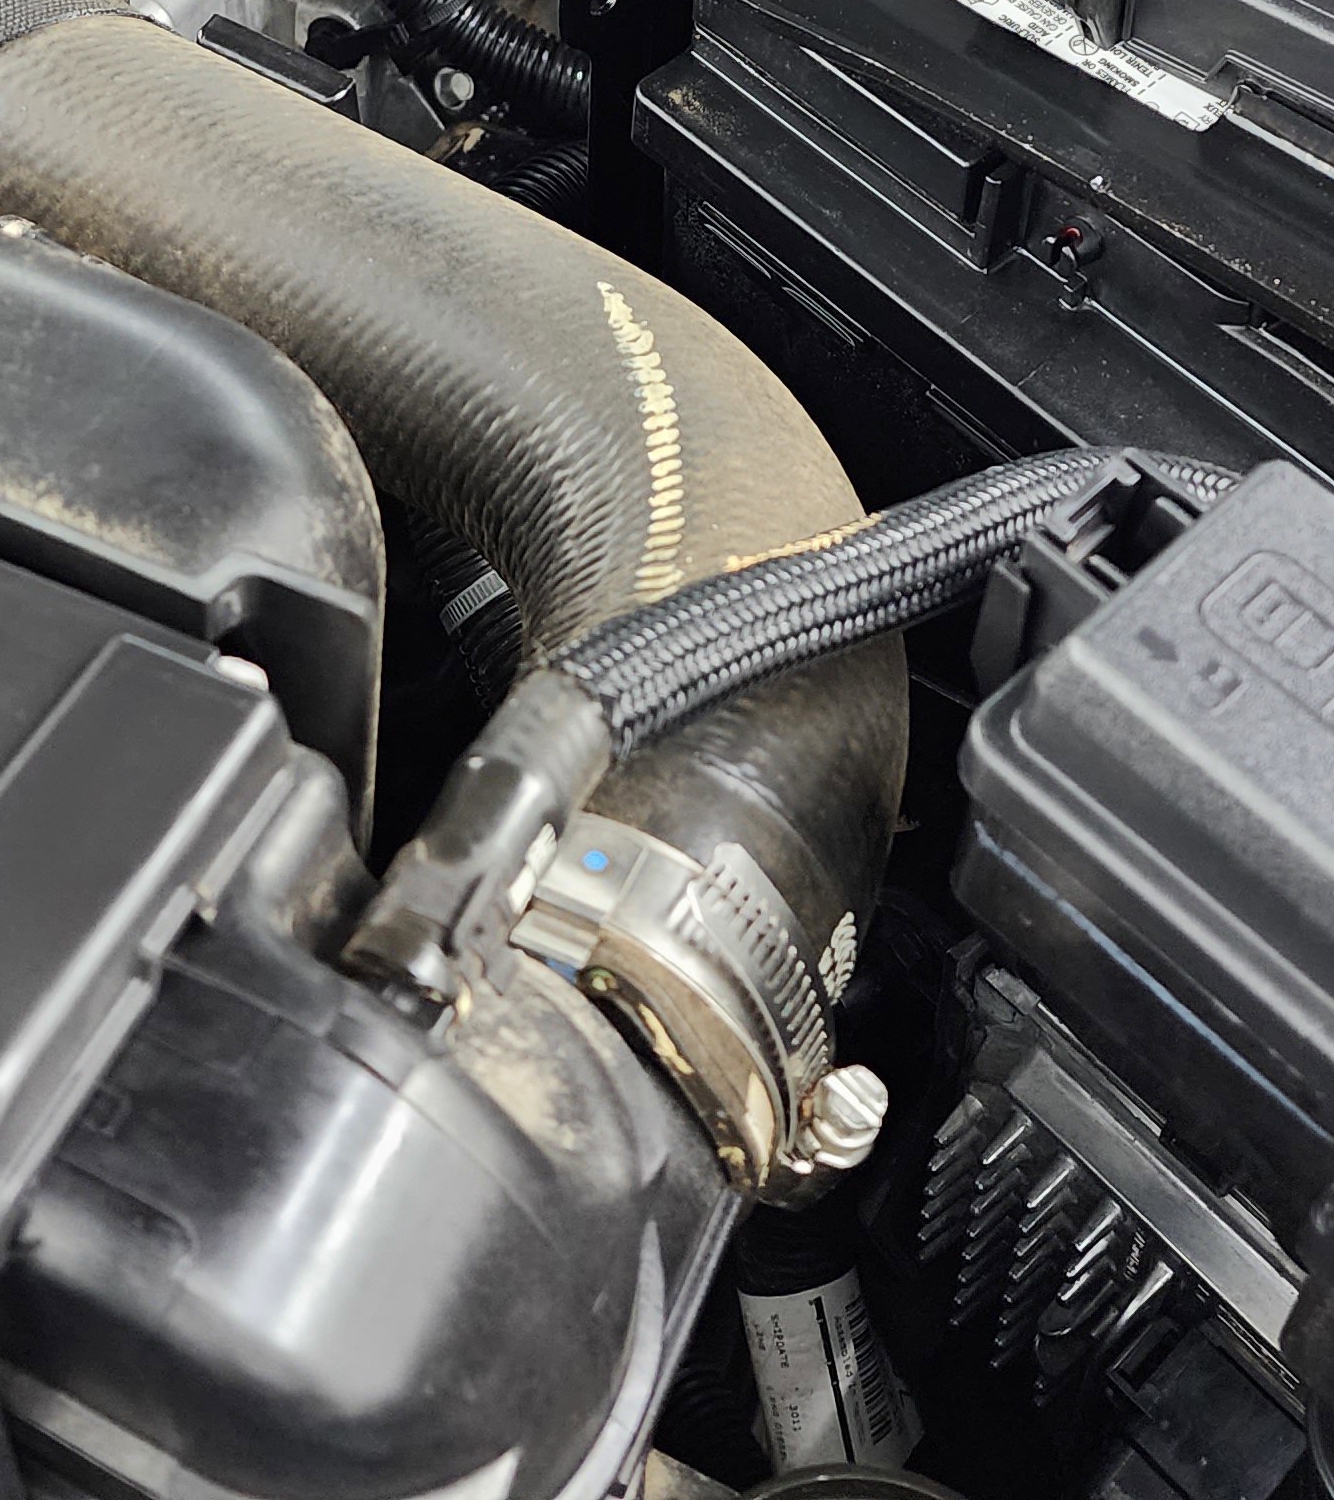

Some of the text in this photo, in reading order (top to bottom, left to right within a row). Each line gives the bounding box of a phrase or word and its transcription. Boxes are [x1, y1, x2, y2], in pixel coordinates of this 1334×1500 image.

[1015, 1, 1043, 20] CAUSE
[1027, 22, 1050, 37] ACID
[1110, 46, 1128, 62] LOI
[1082, 58, 1097, 71] OR
[1098, 57, 1141, 88] SMOKING
[1126, 56, 1154, 78] TENIR
